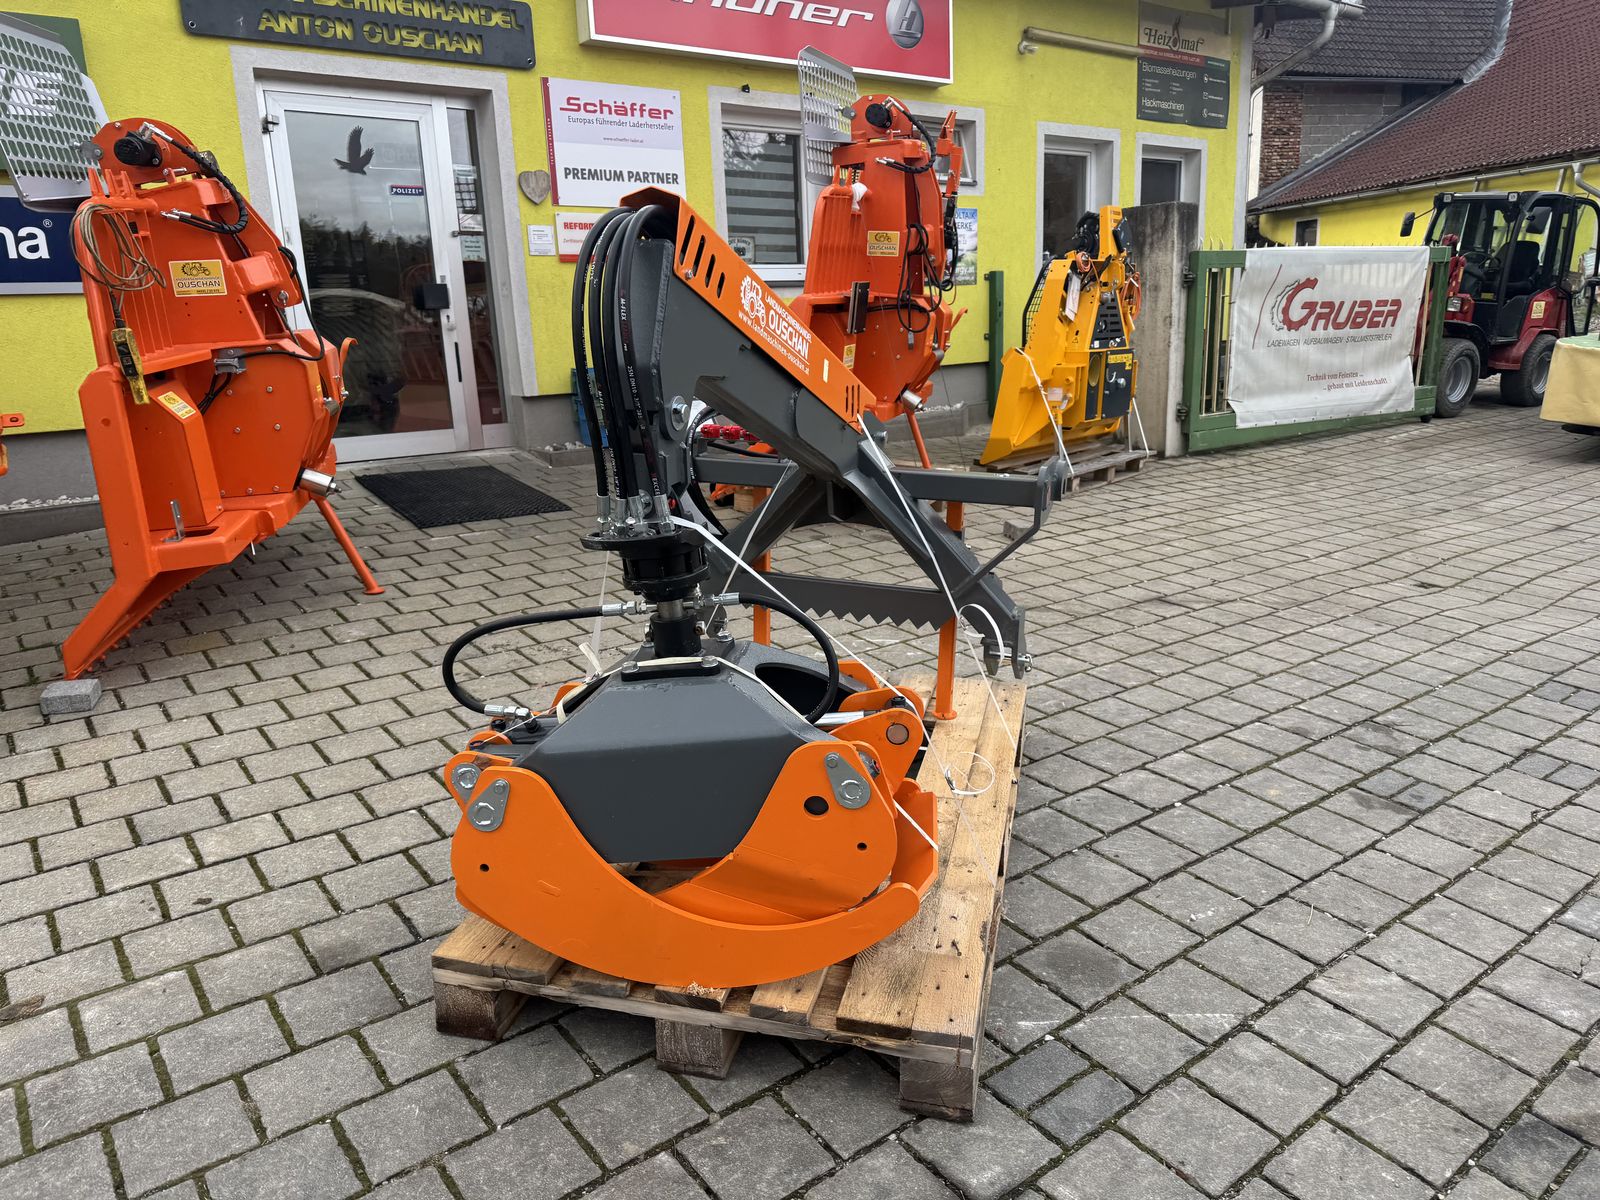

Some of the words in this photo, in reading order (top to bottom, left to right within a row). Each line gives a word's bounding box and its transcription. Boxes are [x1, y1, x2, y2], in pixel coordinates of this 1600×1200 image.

[258, 9, 354, 42] ANTON
[362, 20, 484, 56] OUSCHAN
[1142, 61, 1197, 80] Biomasseheizungen
[559, 96, 674, 120] Schäffer
[1141, 96, 1185, 111] Hackmaschinen
[567, 115, 595, 126] Europas
[595, 117, 628, 128] führender
[628, 119, 675, 131] Laderhersteller
[563, 167, 625, 182] PREMIUM
[627, 170, 679, 185] PARTNER
[391, 187, 419, 195] POLIZEI
[177, 280, 221, 288] OUSCHAN
[1281, 277, 1402, 332] GRUBER
[768, 309, 809, 360] OUSCHAN
[1266, 336, 1300, 348] LADEWAGEN
[1302, 334, 1344, 346] AUFBAUWAGEN
[1345, 333, 1393, 344] STALLMISTSTREUER
[1306, 373, 1327, 382] Technik
[1327, 372, 1338, 380] vom
[1327, 382, 1344, 391] gebaut
